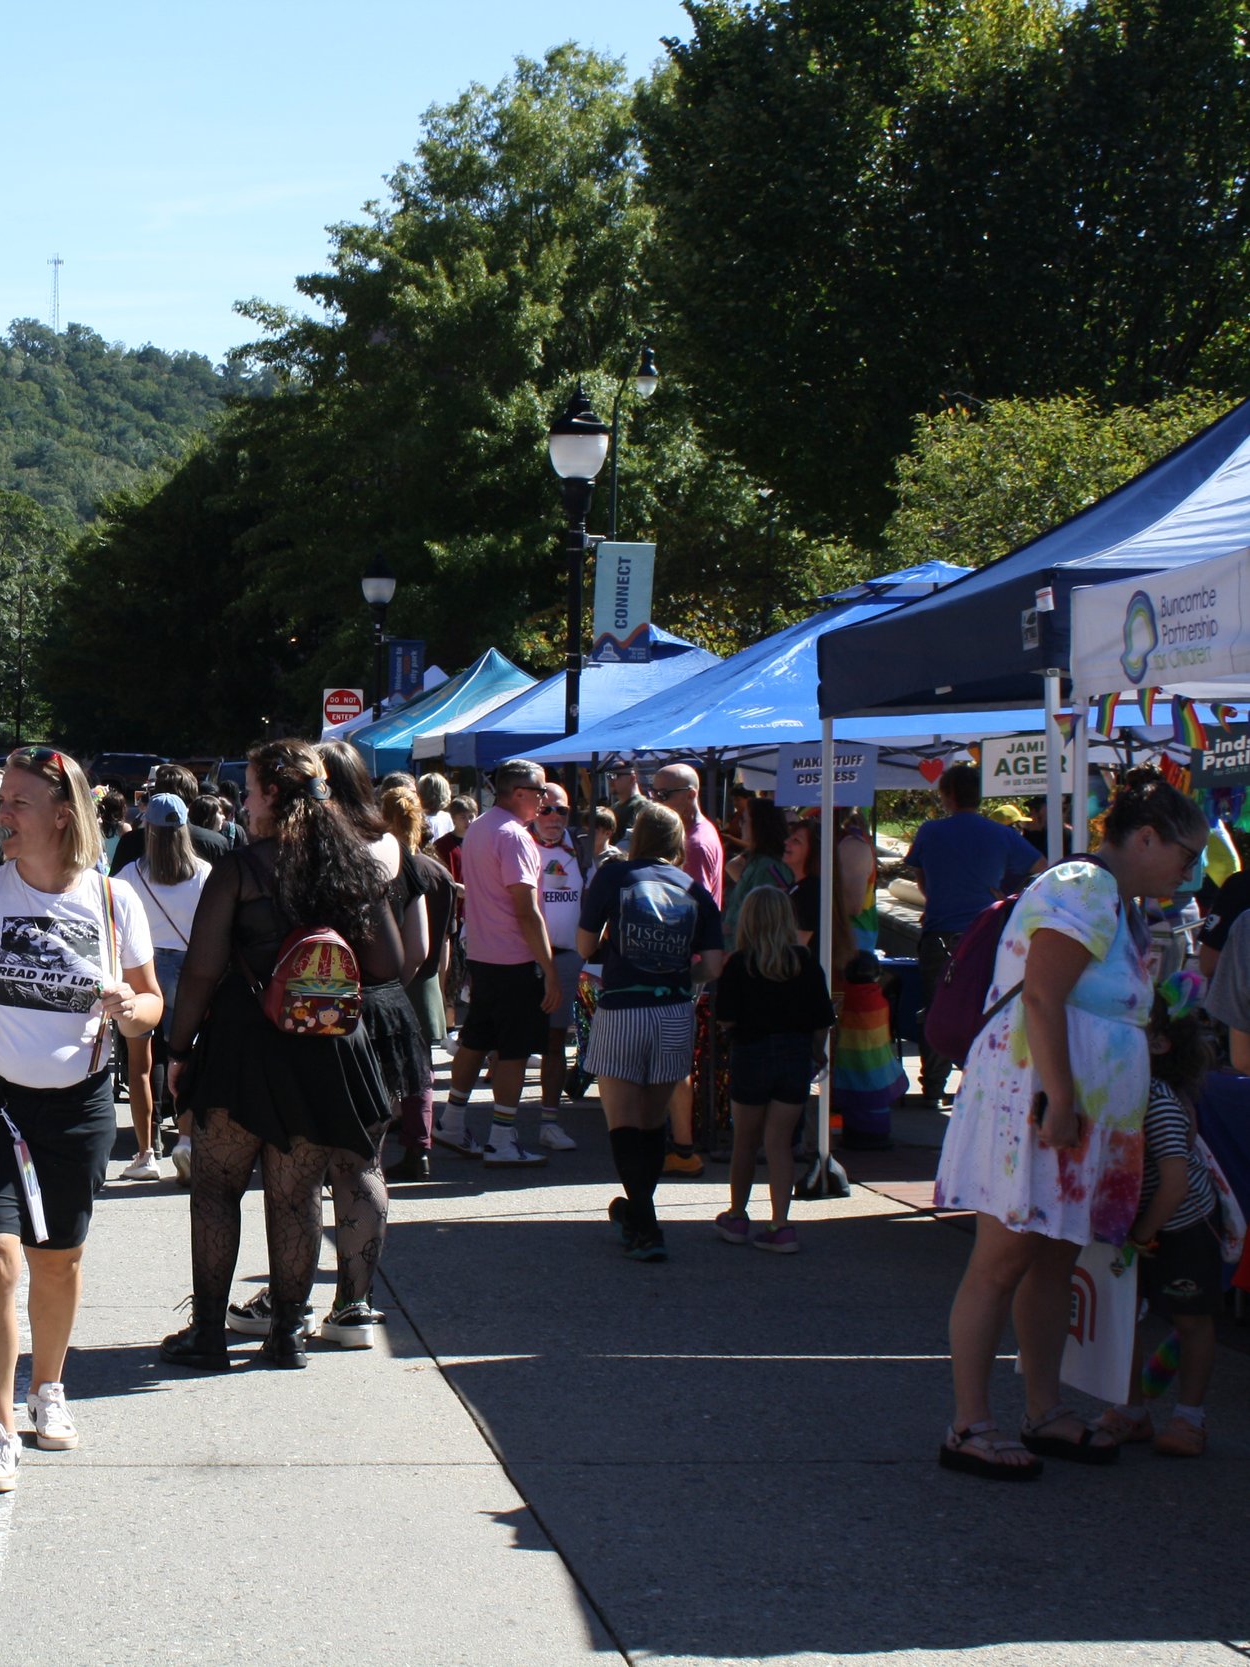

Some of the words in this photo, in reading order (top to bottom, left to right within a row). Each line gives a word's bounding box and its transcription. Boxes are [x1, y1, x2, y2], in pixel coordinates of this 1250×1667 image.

[614, 556, 632, 629] CONNECT
[1161, 585, 1216, 618] Buncombe
[1161, 614, 1219, 647] Partnership
[1169, 645, 1213, 669] Children
[343, 696, 357, 704] NOT
[331, 713, 354, 721] ENTER
[1006, 741, 1047, 754] JAMI
[793, 757, 822, 770] MAK
[796, 773, 822, 785] COS
[832, 771, 857, 783] ESS
[543, 890, 578, 903] EERIOUS
[626, 923, 687, 946] PISGAH
[41, 972, 67, 983] MY
